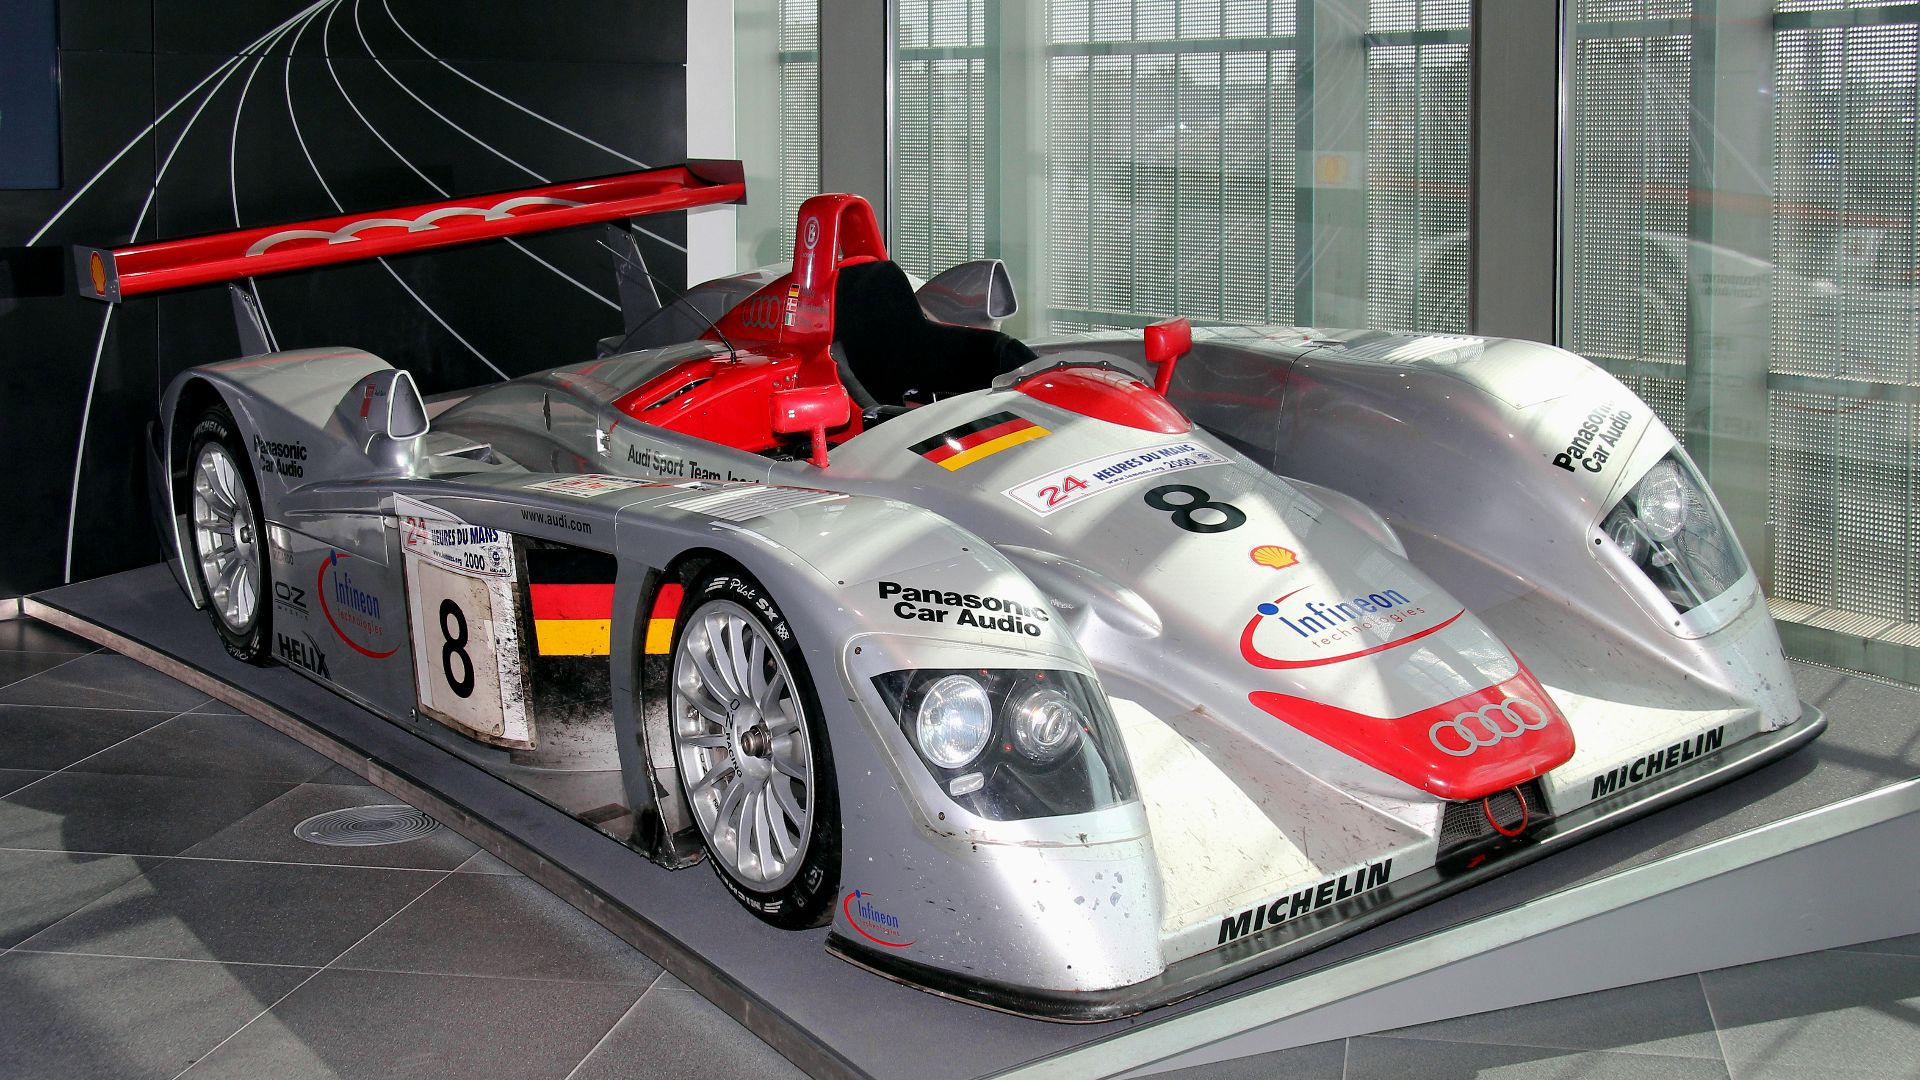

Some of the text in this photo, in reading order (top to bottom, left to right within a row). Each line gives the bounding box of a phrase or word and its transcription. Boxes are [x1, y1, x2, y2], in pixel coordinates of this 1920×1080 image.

[253, 434, 307, 461] Panasonic
[627, 444, 651, 468] Audi
[652, 450, 684, 476] Sport
[689, 461, 721, 481] Team
[1163, 457, 1197, 470] 2000
[1581, 410, 1633, 473] Car Audio
[260, 456, 304, 478] Car Audio
[1038, 444, 1196, 506] 24 HEURES DU MANS
[520, 508, 593, 535] www.audi.com
[1143, 484, 1247, 534] 8
[431, 529, 456, 547] HEURES
[456, 529, 468, 546] DU
[470, 526, 499, 545] MANS
[464, 551, 485, 571] 2000
[333, 569, 381, 620] Infineon
[729, 577, 779, 622] Pilot SX
[878, 581, 1049, 622] Panasonic
[1278, 587, 1411, 638] Infineon
[893, 601, 1042, 637] Car Audio
[1311, 605, 1426, 649] technologies
[277, 631, 332, 682] HELIX
[439, 598, 475, 699] 8
[725, 731, 743, 779] RACING
[1590, 725, 1724, 800] MICHELIN
[858, 900, 899, 928] Infineon
[1217, 858, 1393, 945] MICHELIN
